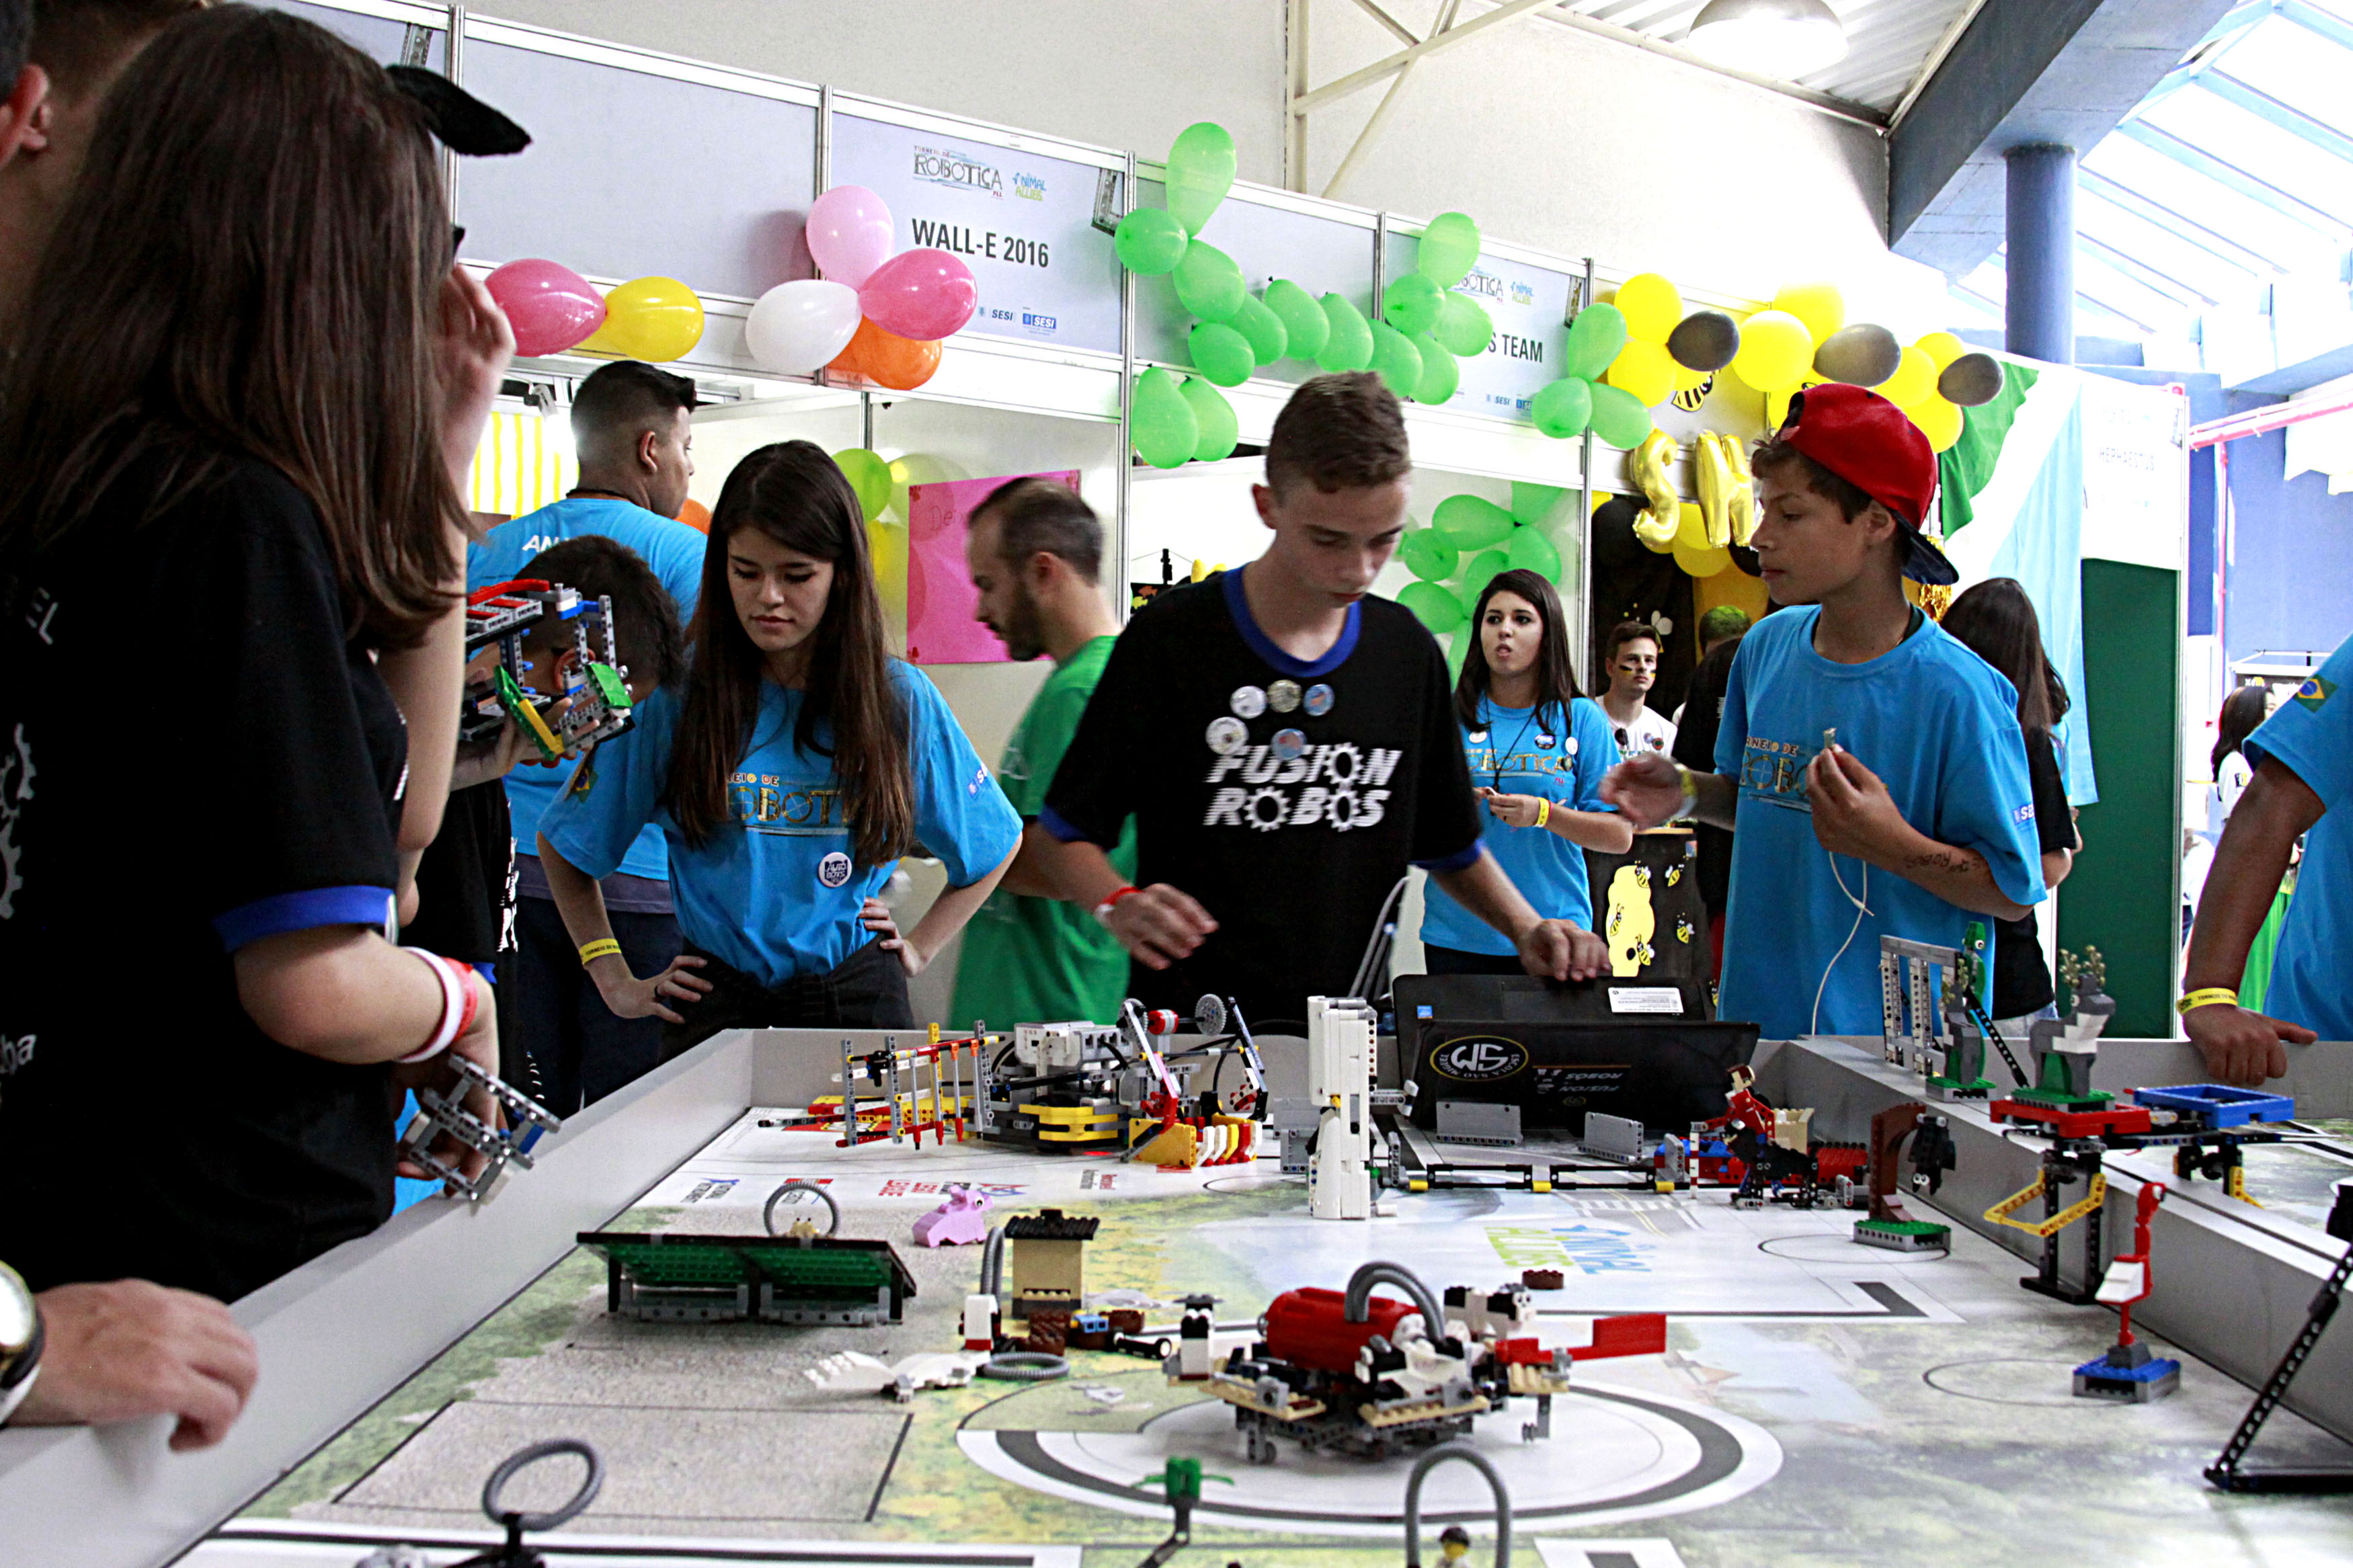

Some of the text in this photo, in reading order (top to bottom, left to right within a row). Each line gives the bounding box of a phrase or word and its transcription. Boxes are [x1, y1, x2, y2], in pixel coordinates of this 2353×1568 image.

[912, 218, 1049, 268] WALL-E 2016
[992, 308, 1055, 329] SESI SESI
[1501, 333, 1543, 364] TEAM
[761, 774, 780, 787] DE
[1203, 741, 1403, 787] FUSION
[1203, 785, 1391, 832] ROBOS
